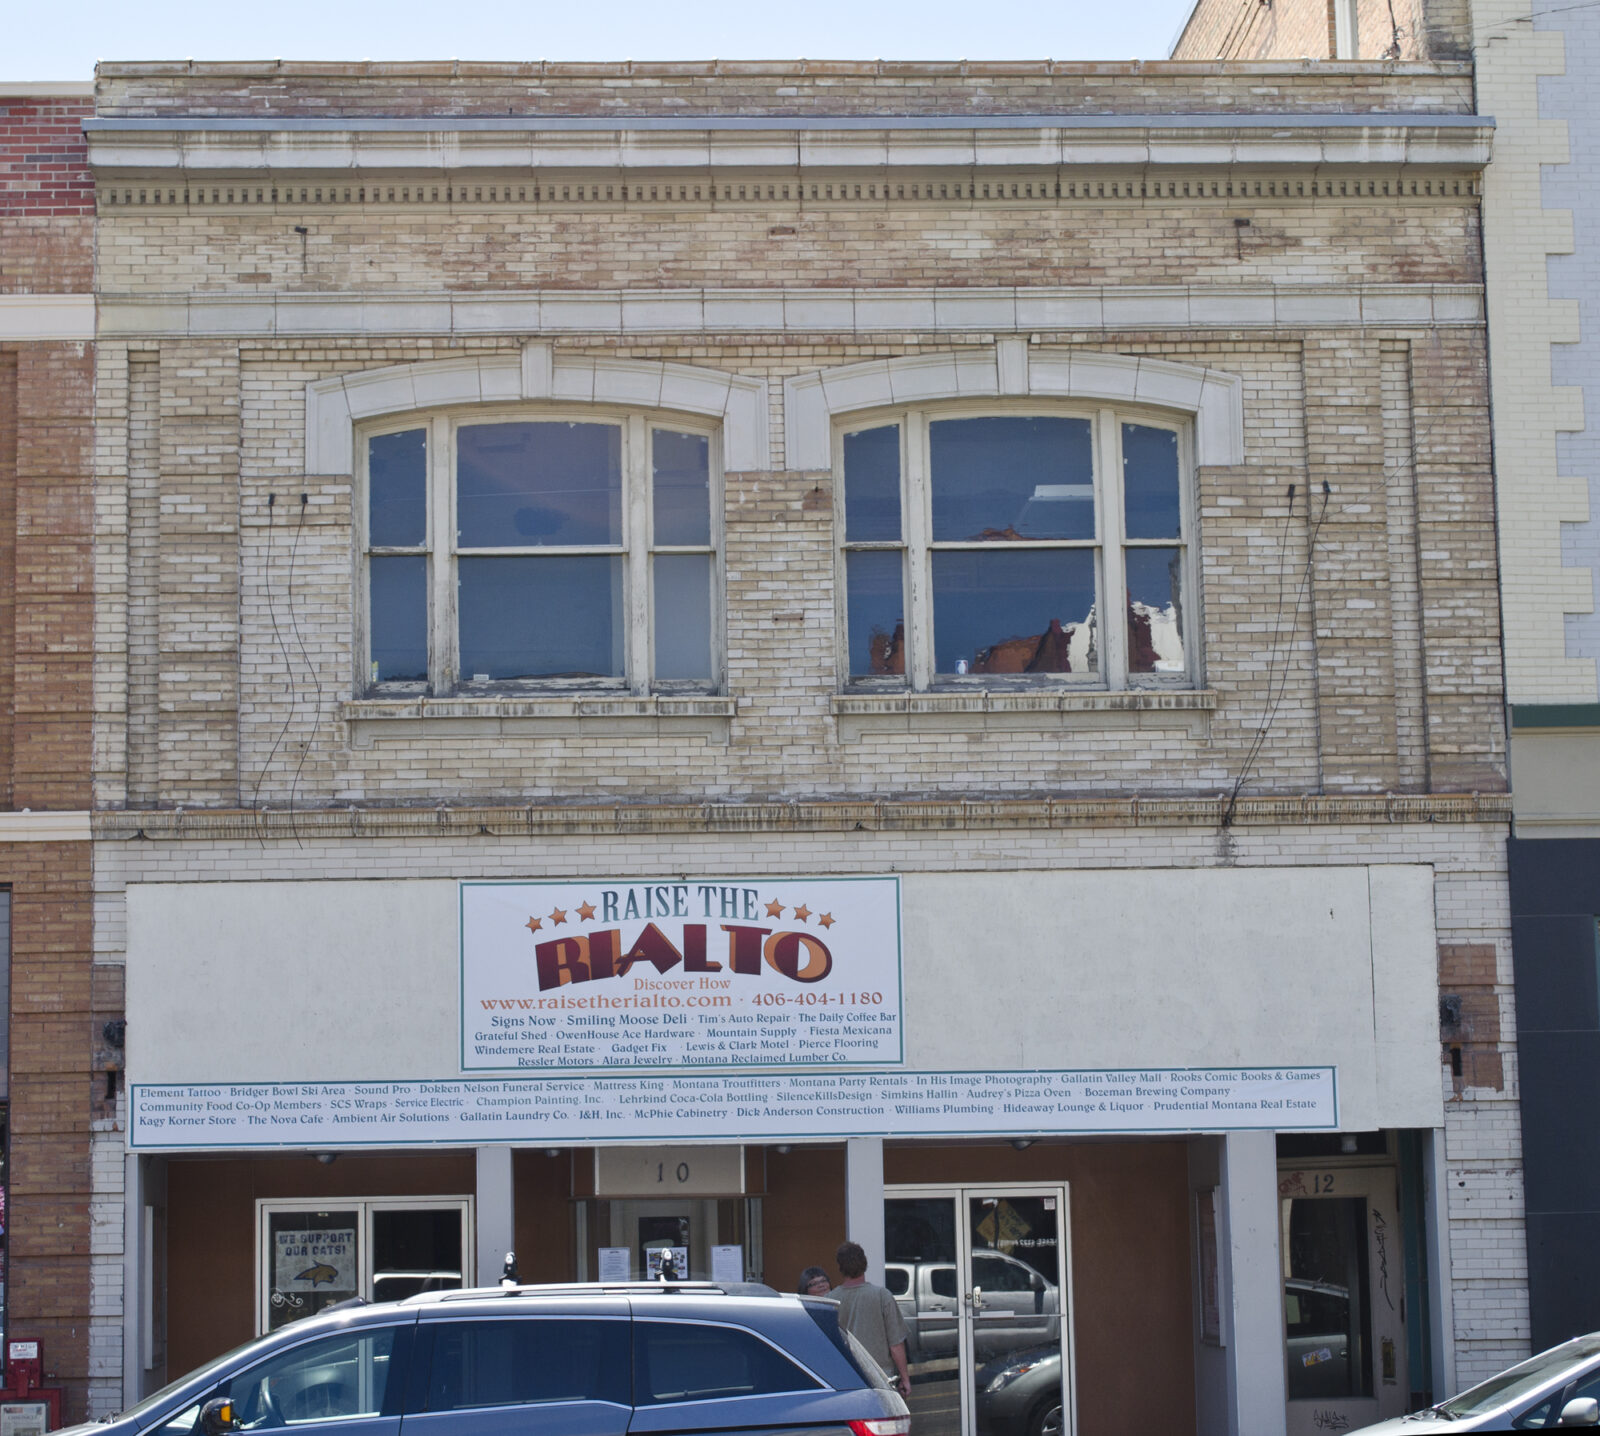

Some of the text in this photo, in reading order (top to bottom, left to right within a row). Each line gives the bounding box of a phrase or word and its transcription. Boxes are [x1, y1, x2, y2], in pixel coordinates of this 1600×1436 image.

[601, 885, 759, 923] RAISE THE
[535, 922, 833, 992] RIALTO
[633, 977, 731, 990] Discover How
[480, 991, 882, 1010] www.raisetherialto.com 406-404-1180
[490, 1012, 896, 1028] Signs Now Smiling Moose Deli Tim's Auto Repair The Daily Coffee Bar
[474, 1025, 892, 1040] Grateful Shed OwenHouse Ace Hardware Mountain Supply Fiesta Mexicana
[474, 1038, 878, 1055] Windemere Real Estate Gadget Fix Lewis & Clark Motel Pierce Flooring
[517, 1056, 555, 1066] Ressler
[556, 1056, 594, 1065] Motors
[602, 1055, 630, 1065] Alara
[632, 1055, 672, 1065] Jewelry
[681, 1054, 728, 1064] Montana
[731, 1053, 786, 1063] Reclaimed
[788, 1052, 829, 1062] Lumber
[139, 1071, 1320, 1098] Element Tattoo Bridger Bowl Ski Area Sound Pro Dokken Nelson Funeral Service Mattress King Montana Troutfitters Montana Party Rentals In His Image Photography Gallatin Valley Mall Rooks Comic Books & Games
[139, 1101, 204, 1113] Community
[206, 1101, 232, 1111] Food
[235, 1100, 271, 1112] Co-Op
[273, 1099, 322, 1109] Members
[329, 1099, 352, 1109] SCS
[353, 1098, 387, 1110] Wraps
[394, 1097, 428, 1107] Service
[430, 1097, 464, 1106] Electric
[476, 1096, 532, 1107] Champion
[618, 1094, 667, 1104] Lehrkind
[669, 1092, 723, 1103] Coca-Cola
[726, 1092, 768, 1103] Bottling
[880, 1089, 924, 1099] Simkins
[926, 1088, 958, 1099] Hallin
[966, 1088, 1012, 1100] Audrey's
[1014, 1088, 1040, 1097] Pizza
[1043, 1087, 1071, 1097] Oven
[1084, 1087, 1132, 1096] Bozeman
[1135, 1086, 1178, 1098] Brewing
[1180, 1085, 1230, 1097] Company
[139, 1115, 166, 1127] Kagy
[168, 1115, 206, 1125] Korner
[208, 1115, 236, 1125] Store
[247, 1115, 268, 1124] The
[270, 1114, 297, 1124] Nova
[299, 1114, 324, 1123] Cafe
[331, 1113, 377, 1123] Ambient
[379, 1113, 396, 1122] Air
[398, 1112, 450, 1122] Solutions
[459, 1111, 502, 1121] Gallatin
[505, 1110, 550, 1122] Laundry
[634, 1108, 673, 1118] McPhie
[675, 1108, 728, 1119] Cabinetry
[736, 1107, 760, 1116] Dick
[762, 1106, 813, 1116] Anderson
[815, 1105, 884, 1115] Construction
[894, 1104, 940, 1114] Williams
[942, 1103, 994, 1115] Plumbing
[1002, 1102, 1054, 1114] Hideaway
[1056, 1102, 1096, 1113] Lounge
[1098, 1102, 1107, 1111] &
[1109, 1101, 1144, 1112] Liquor
[1153, 1100, 1208, 1110] Prudential
[1211, 1099, 1257, 1109] Montana
[1260, 1099, 1282, 1108] Real
[1285, 1098, 1316, 1108] Estate
[657, 1162, 689, 1182] 10
[1314, 1174, 1334, 1194] 12
[279, 1233, 352, 1244] WE SUPPORT
[286, 1245, 346, 1256] OUR CATS!
